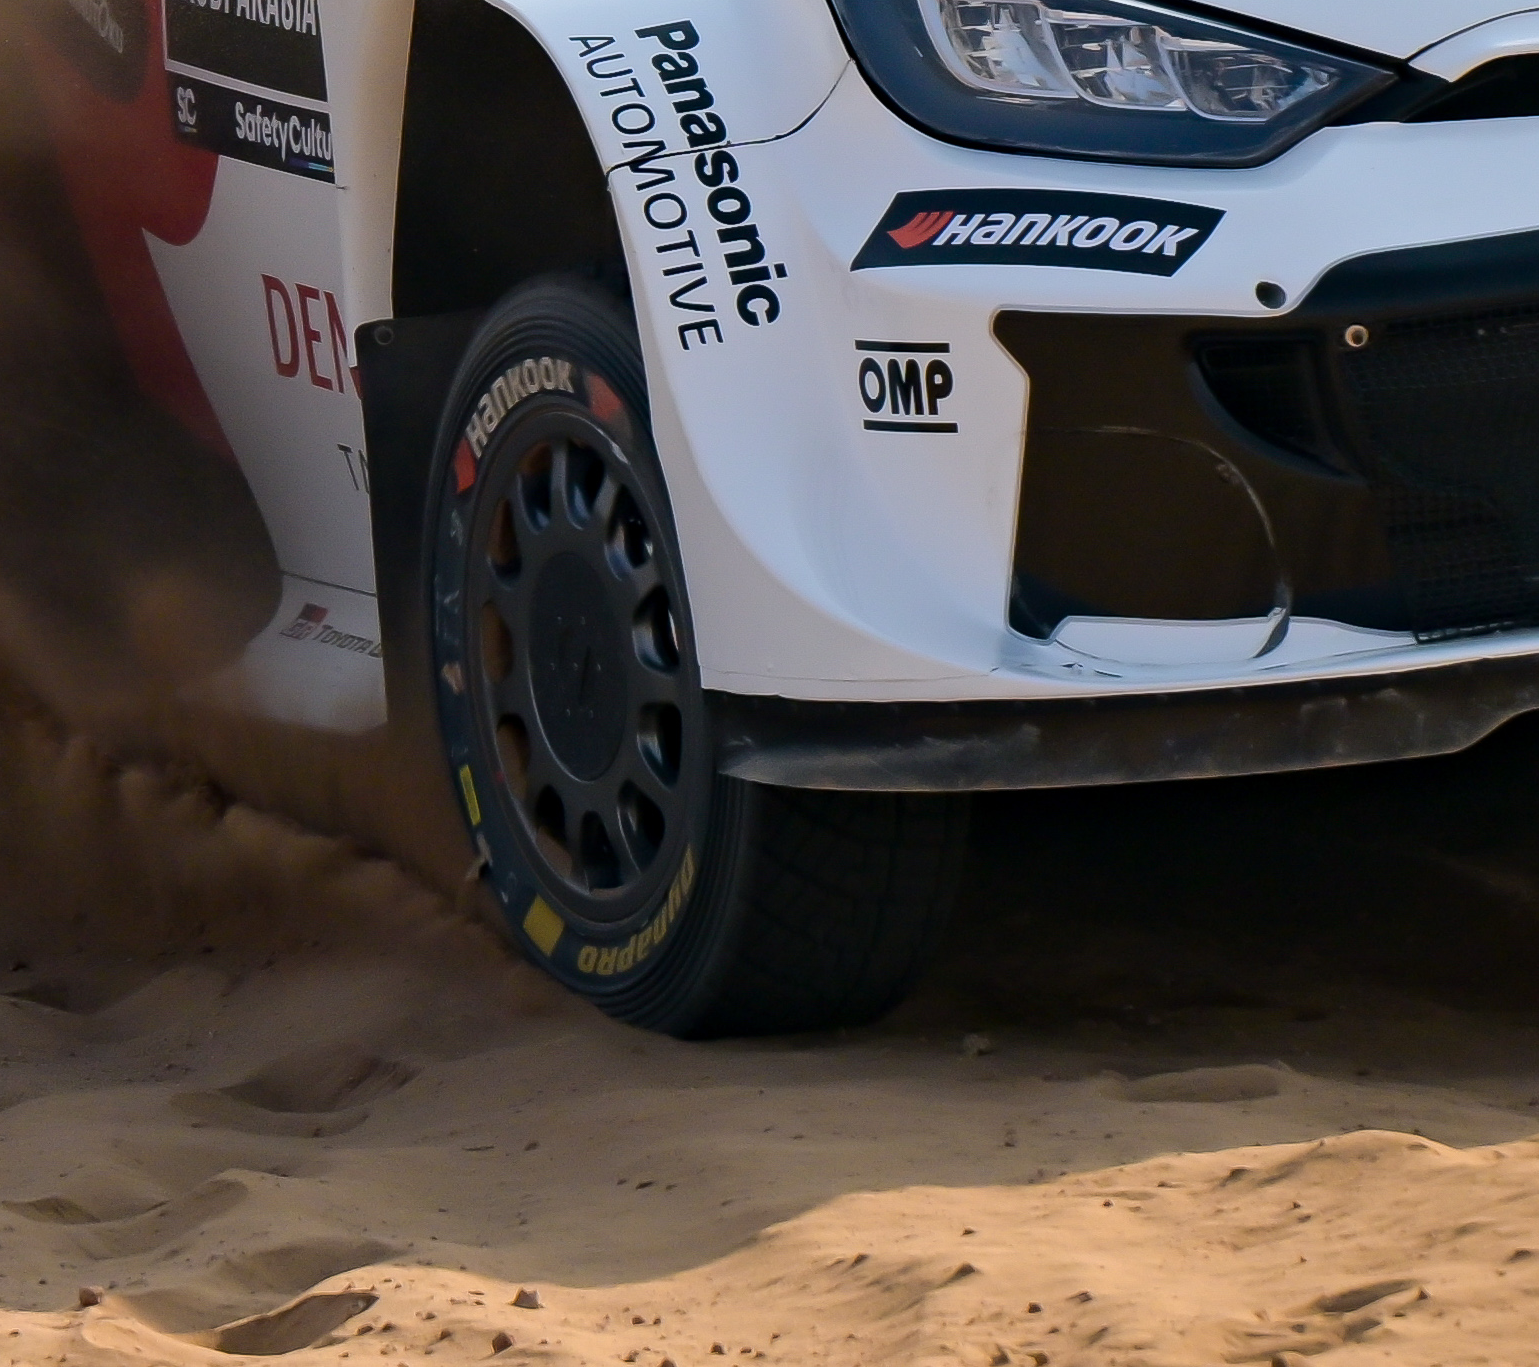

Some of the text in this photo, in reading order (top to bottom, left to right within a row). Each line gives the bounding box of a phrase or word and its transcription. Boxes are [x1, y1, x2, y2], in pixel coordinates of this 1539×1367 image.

[177, 86, 197, 125] SC
[568, 36, 724, 351] AUTOMOTIVE
[634, 19, 789, 327] Panasonic
[261, 273, 363, 400] DEN
[858, 357, 954, 417] OMP
